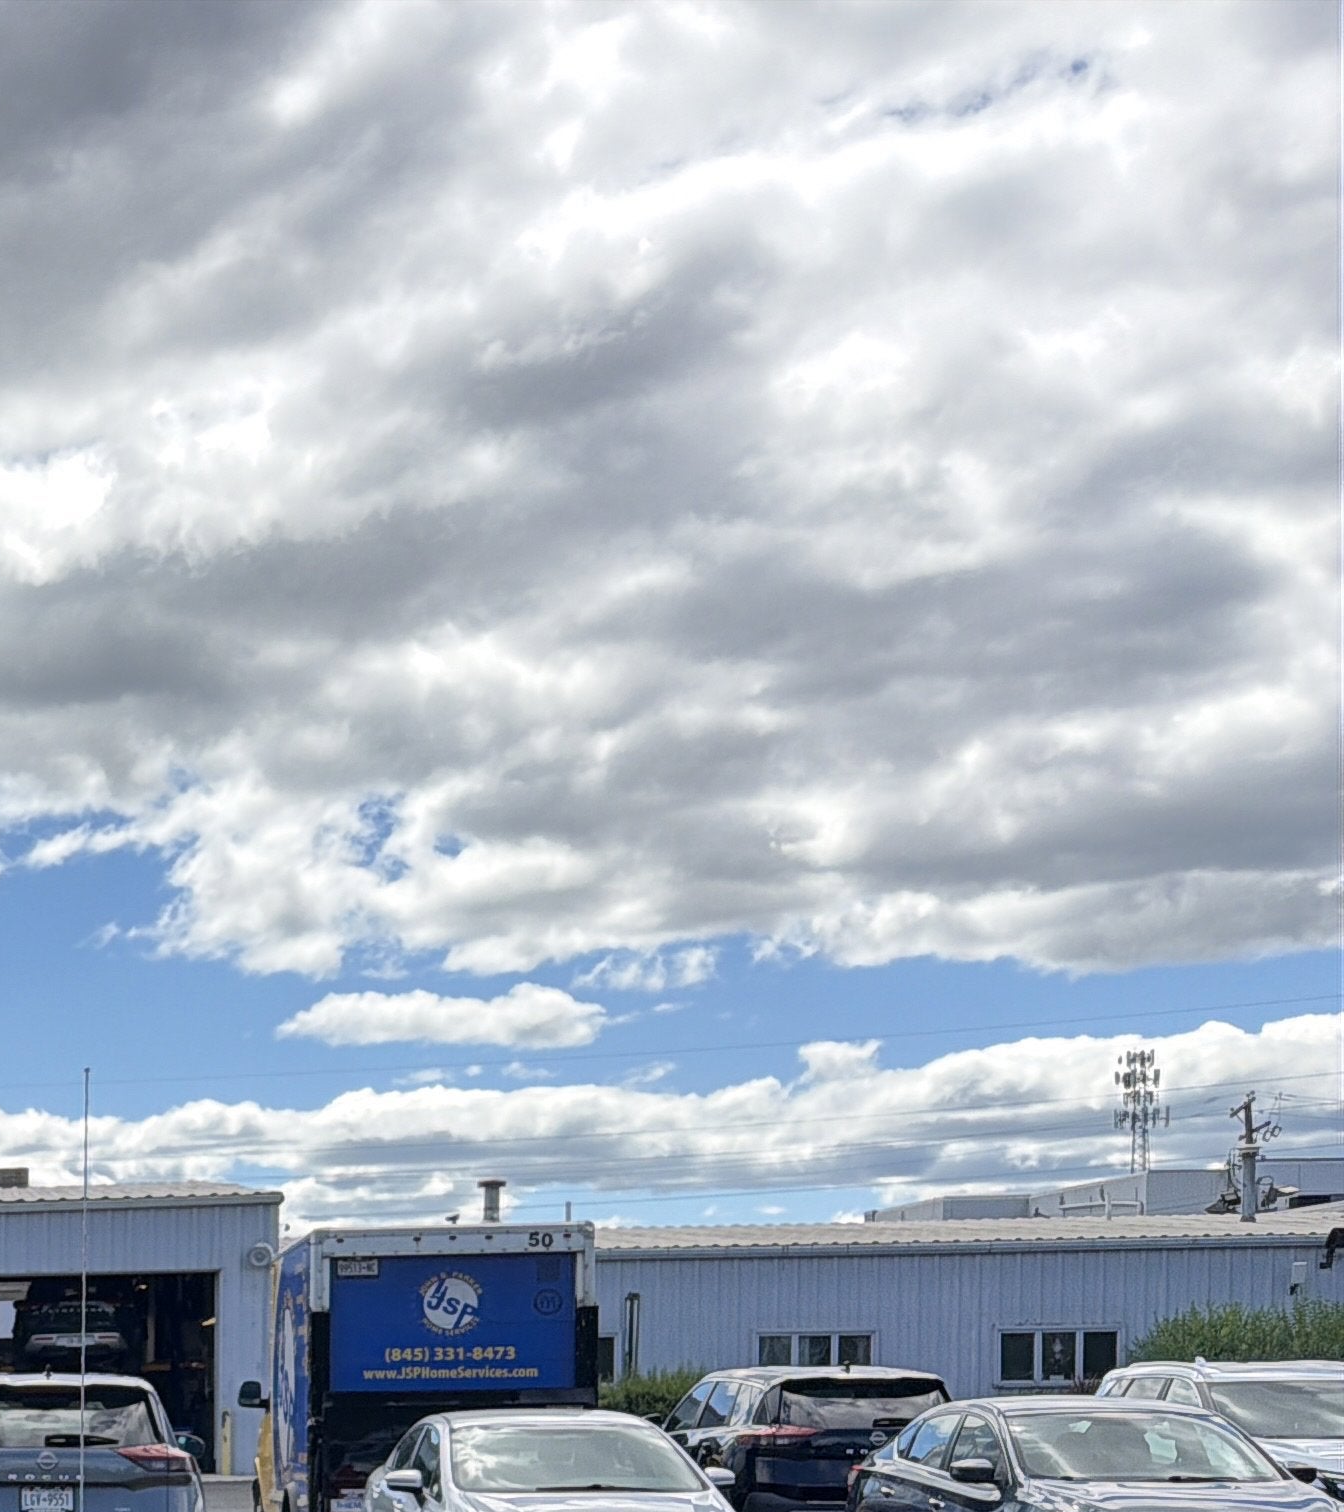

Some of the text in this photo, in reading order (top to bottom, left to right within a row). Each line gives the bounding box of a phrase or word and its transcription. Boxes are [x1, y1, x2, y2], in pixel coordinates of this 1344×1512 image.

[528, 1231, 554, 1247] 50
[384, 1346, 516, 1363] (845) 331-8473
[363, 1365, 539, 1380] www.JSPHomeServices.com
